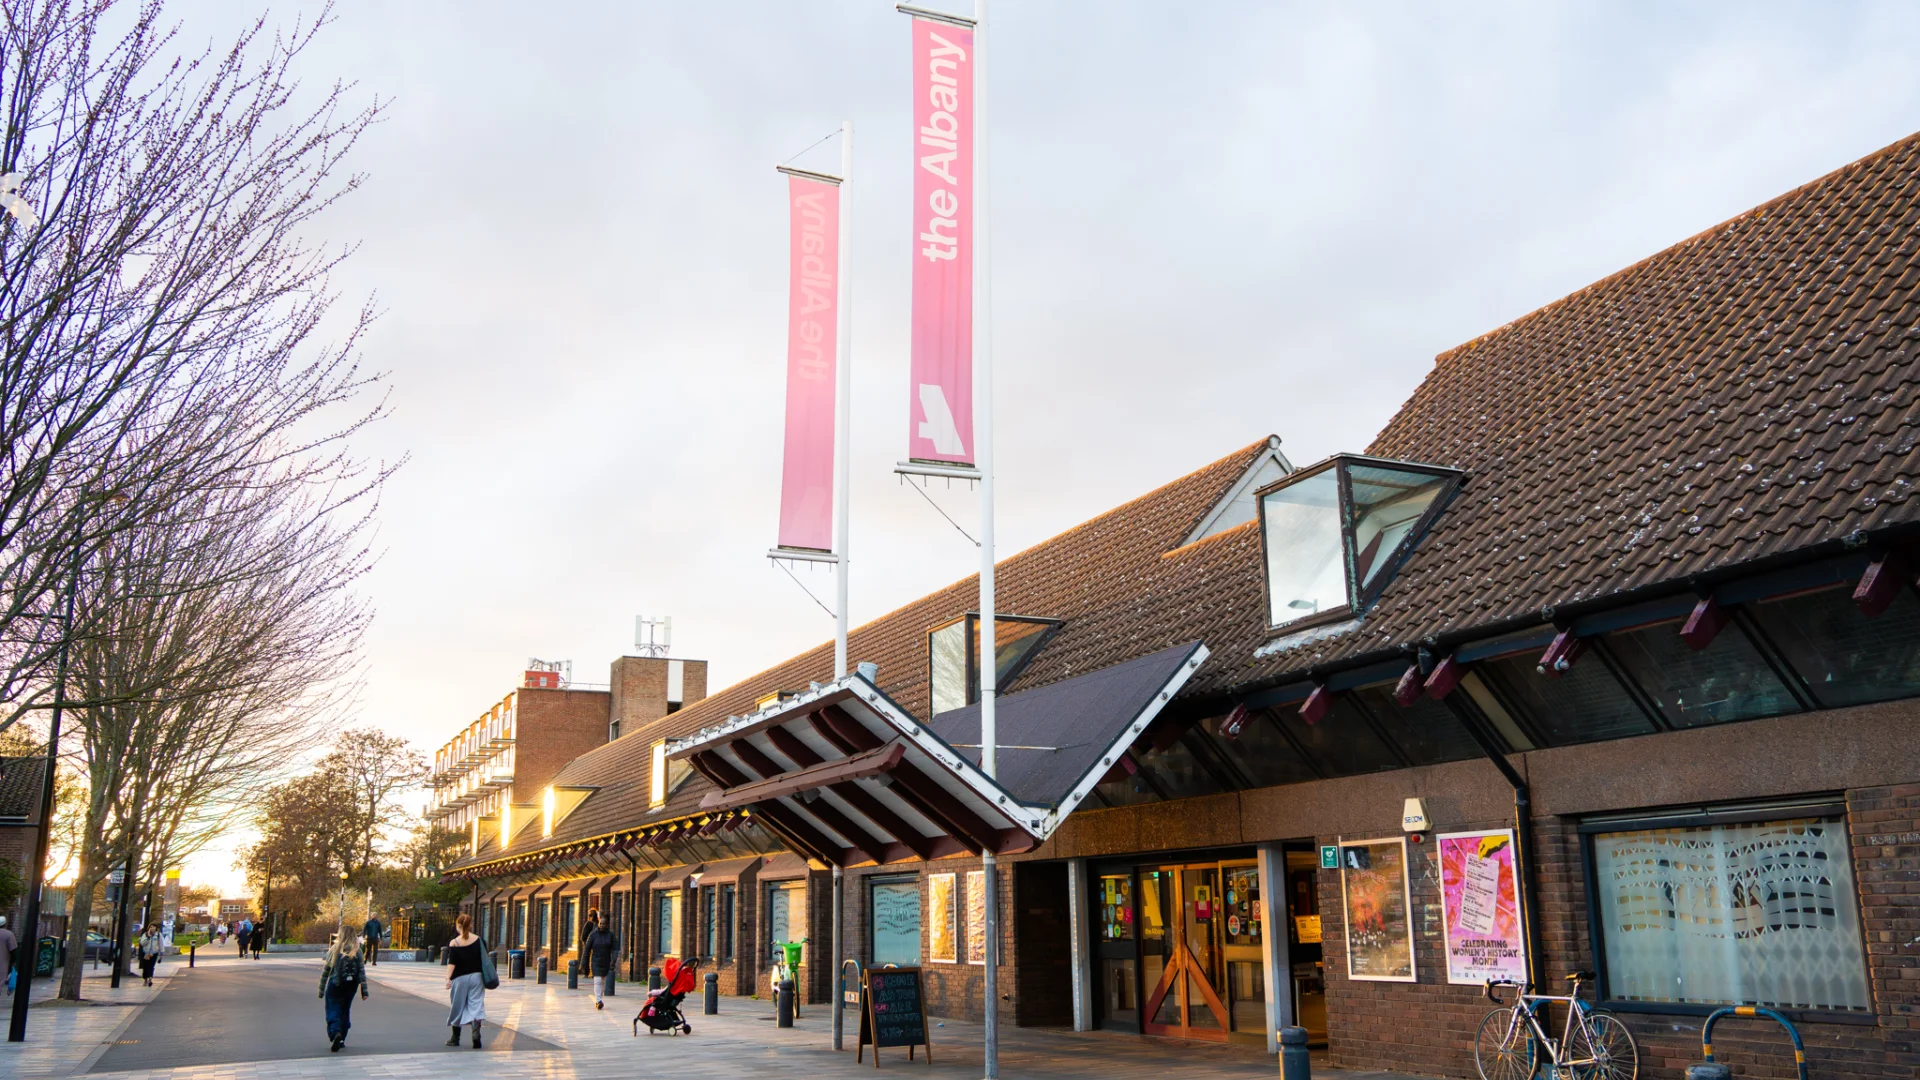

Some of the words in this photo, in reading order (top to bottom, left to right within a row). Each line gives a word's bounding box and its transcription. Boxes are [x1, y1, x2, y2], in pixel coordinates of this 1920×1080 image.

[920, 32, 966, 186] Albany
[920, 189, 958, 263] the
[1404, 815, 1423, 824] SECOM
[1461, 940, 1508, 949] CELEBRATING
[1452, 948, 1485, 957] WOMEN'S
[1487, 949, 1518, 958] HISTORY
[1472, 957, 1498, 966] MONTH
[885, 975, 915, 987] COME
[878, 989, 895, 1002] AS
[896, 988, 916, 1000] YOU
[889, 1002, 913, 1013] ARE
